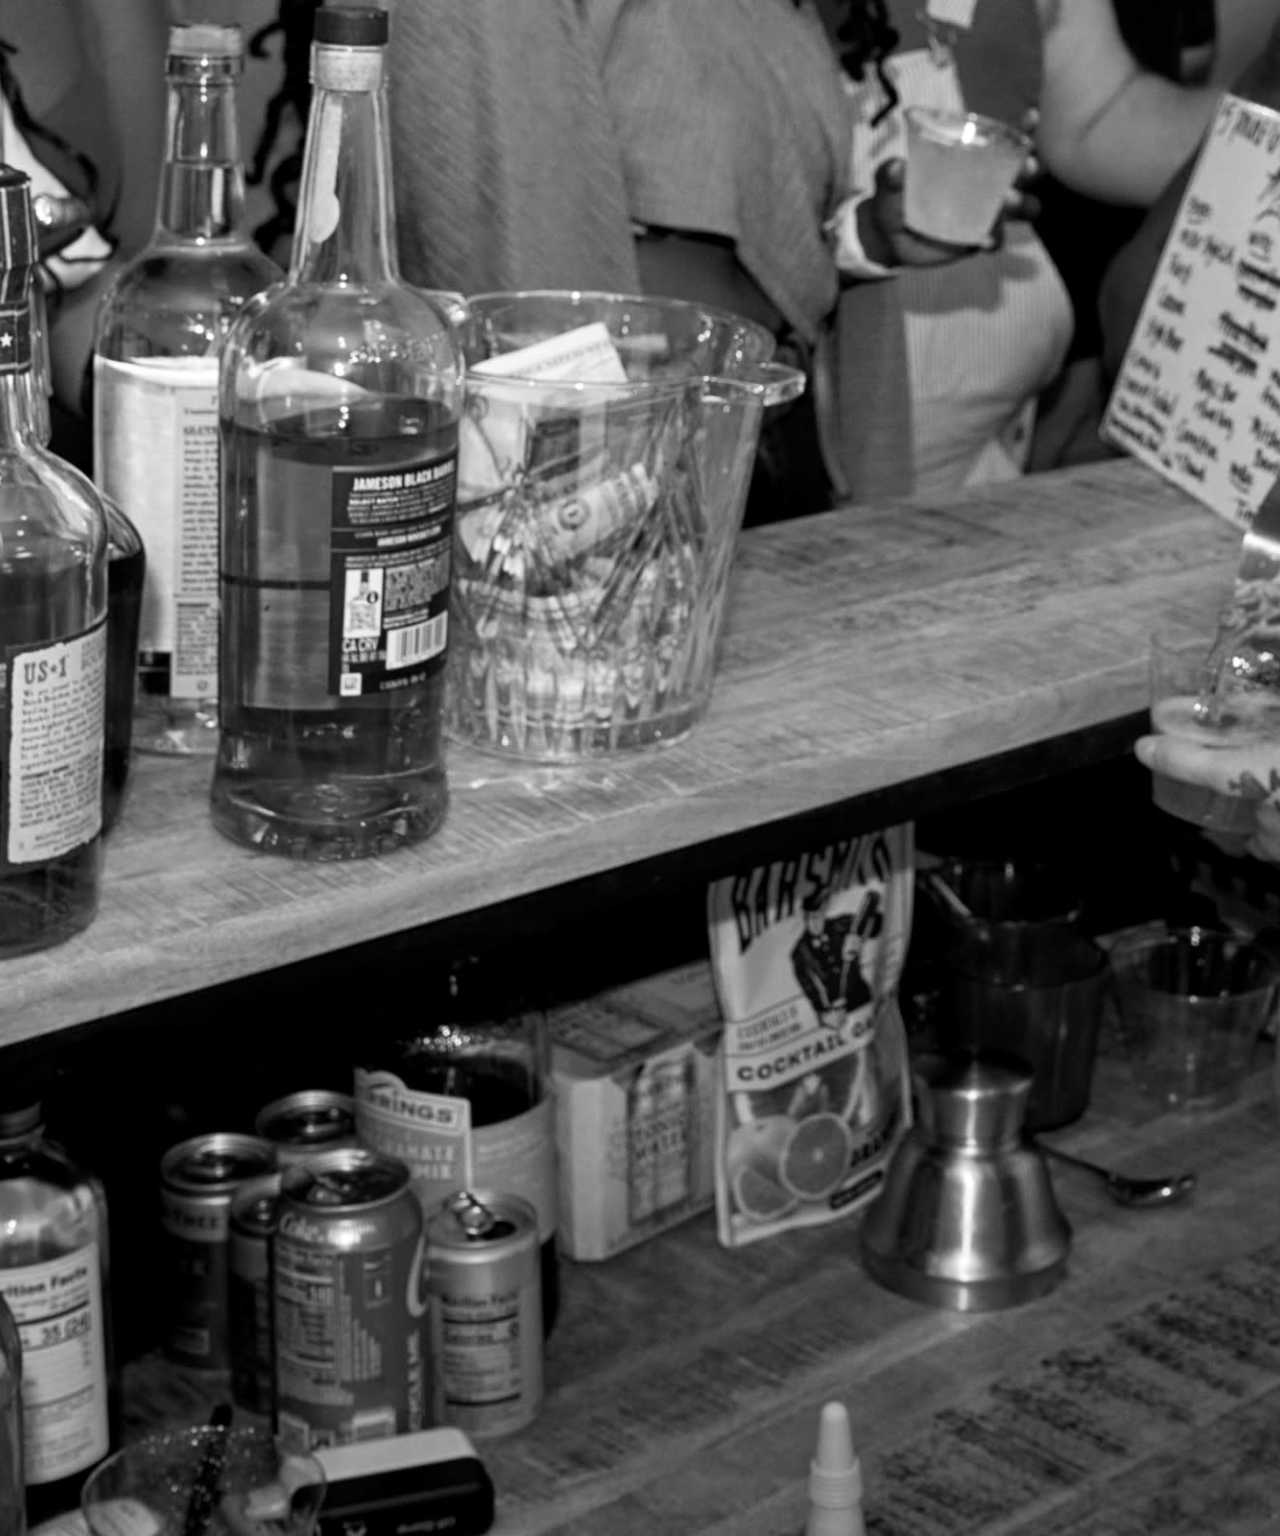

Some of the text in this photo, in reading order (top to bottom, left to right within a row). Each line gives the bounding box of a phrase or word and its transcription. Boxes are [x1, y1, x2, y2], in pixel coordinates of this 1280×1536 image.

[353, 474, 403, 492] JAMESON
[404, 469, 433, 487] BLACK
[737, 1033, 846, 1082] COCKTAIL
